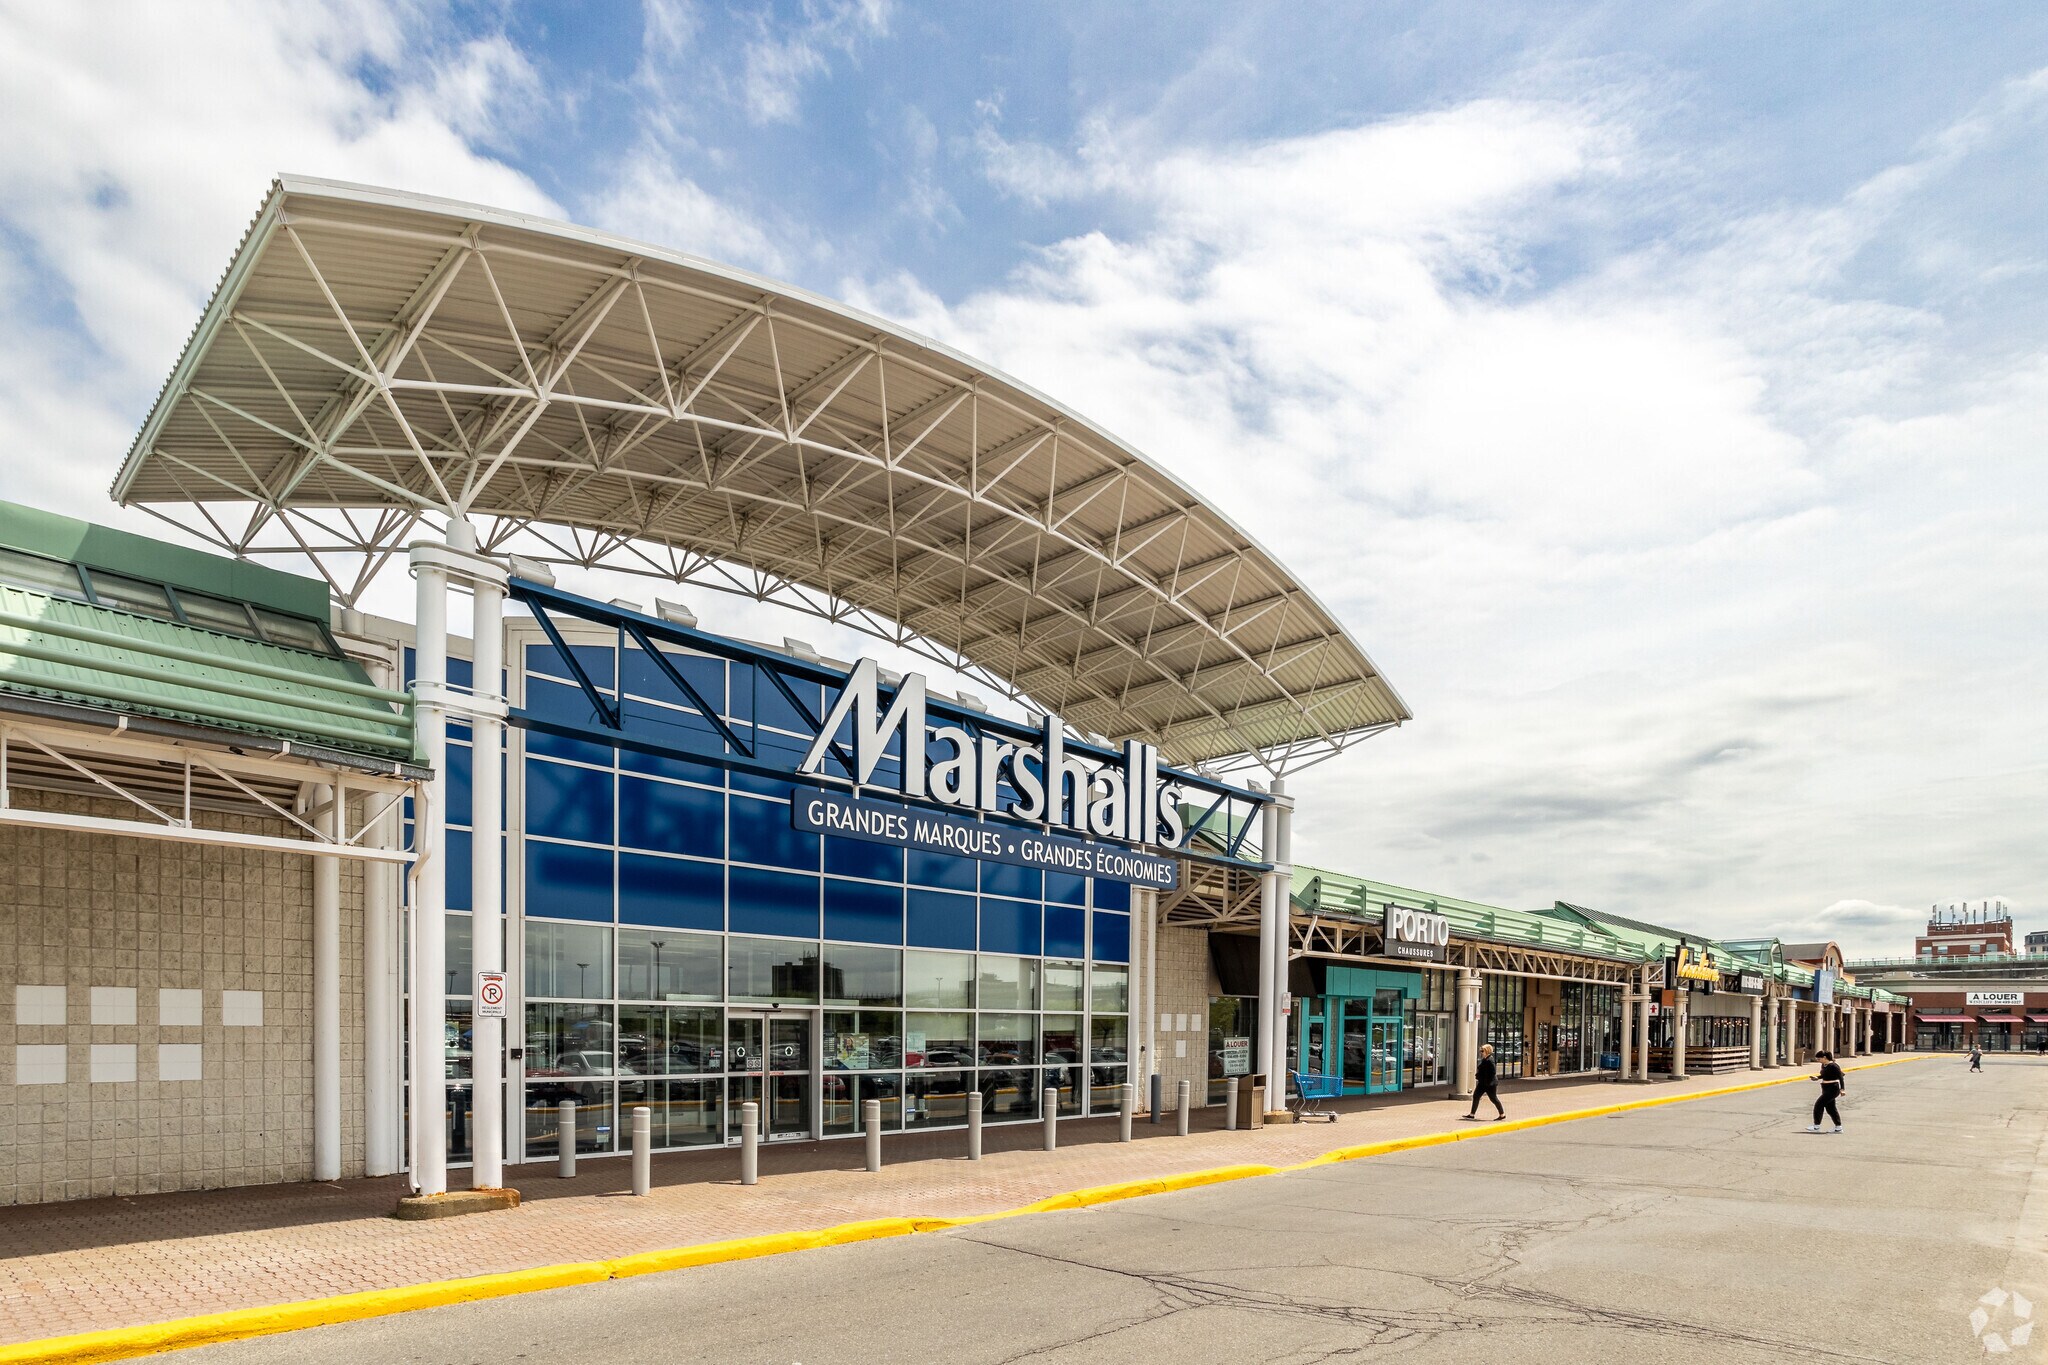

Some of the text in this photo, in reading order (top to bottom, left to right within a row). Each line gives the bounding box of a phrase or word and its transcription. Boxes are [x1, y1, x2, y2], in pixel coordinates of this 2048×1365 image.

[798, 656, 1183, 849] Marshalls
[807, 799, 1172, 884] GRANDES MARQUES GRANDES ÉCONOMIES
[1387, 907, 1449, 947] PORTO
[1397, 946, 1434, 958] CHAUSSURES
[1231, 1040, 1248, 1048] LOUER
